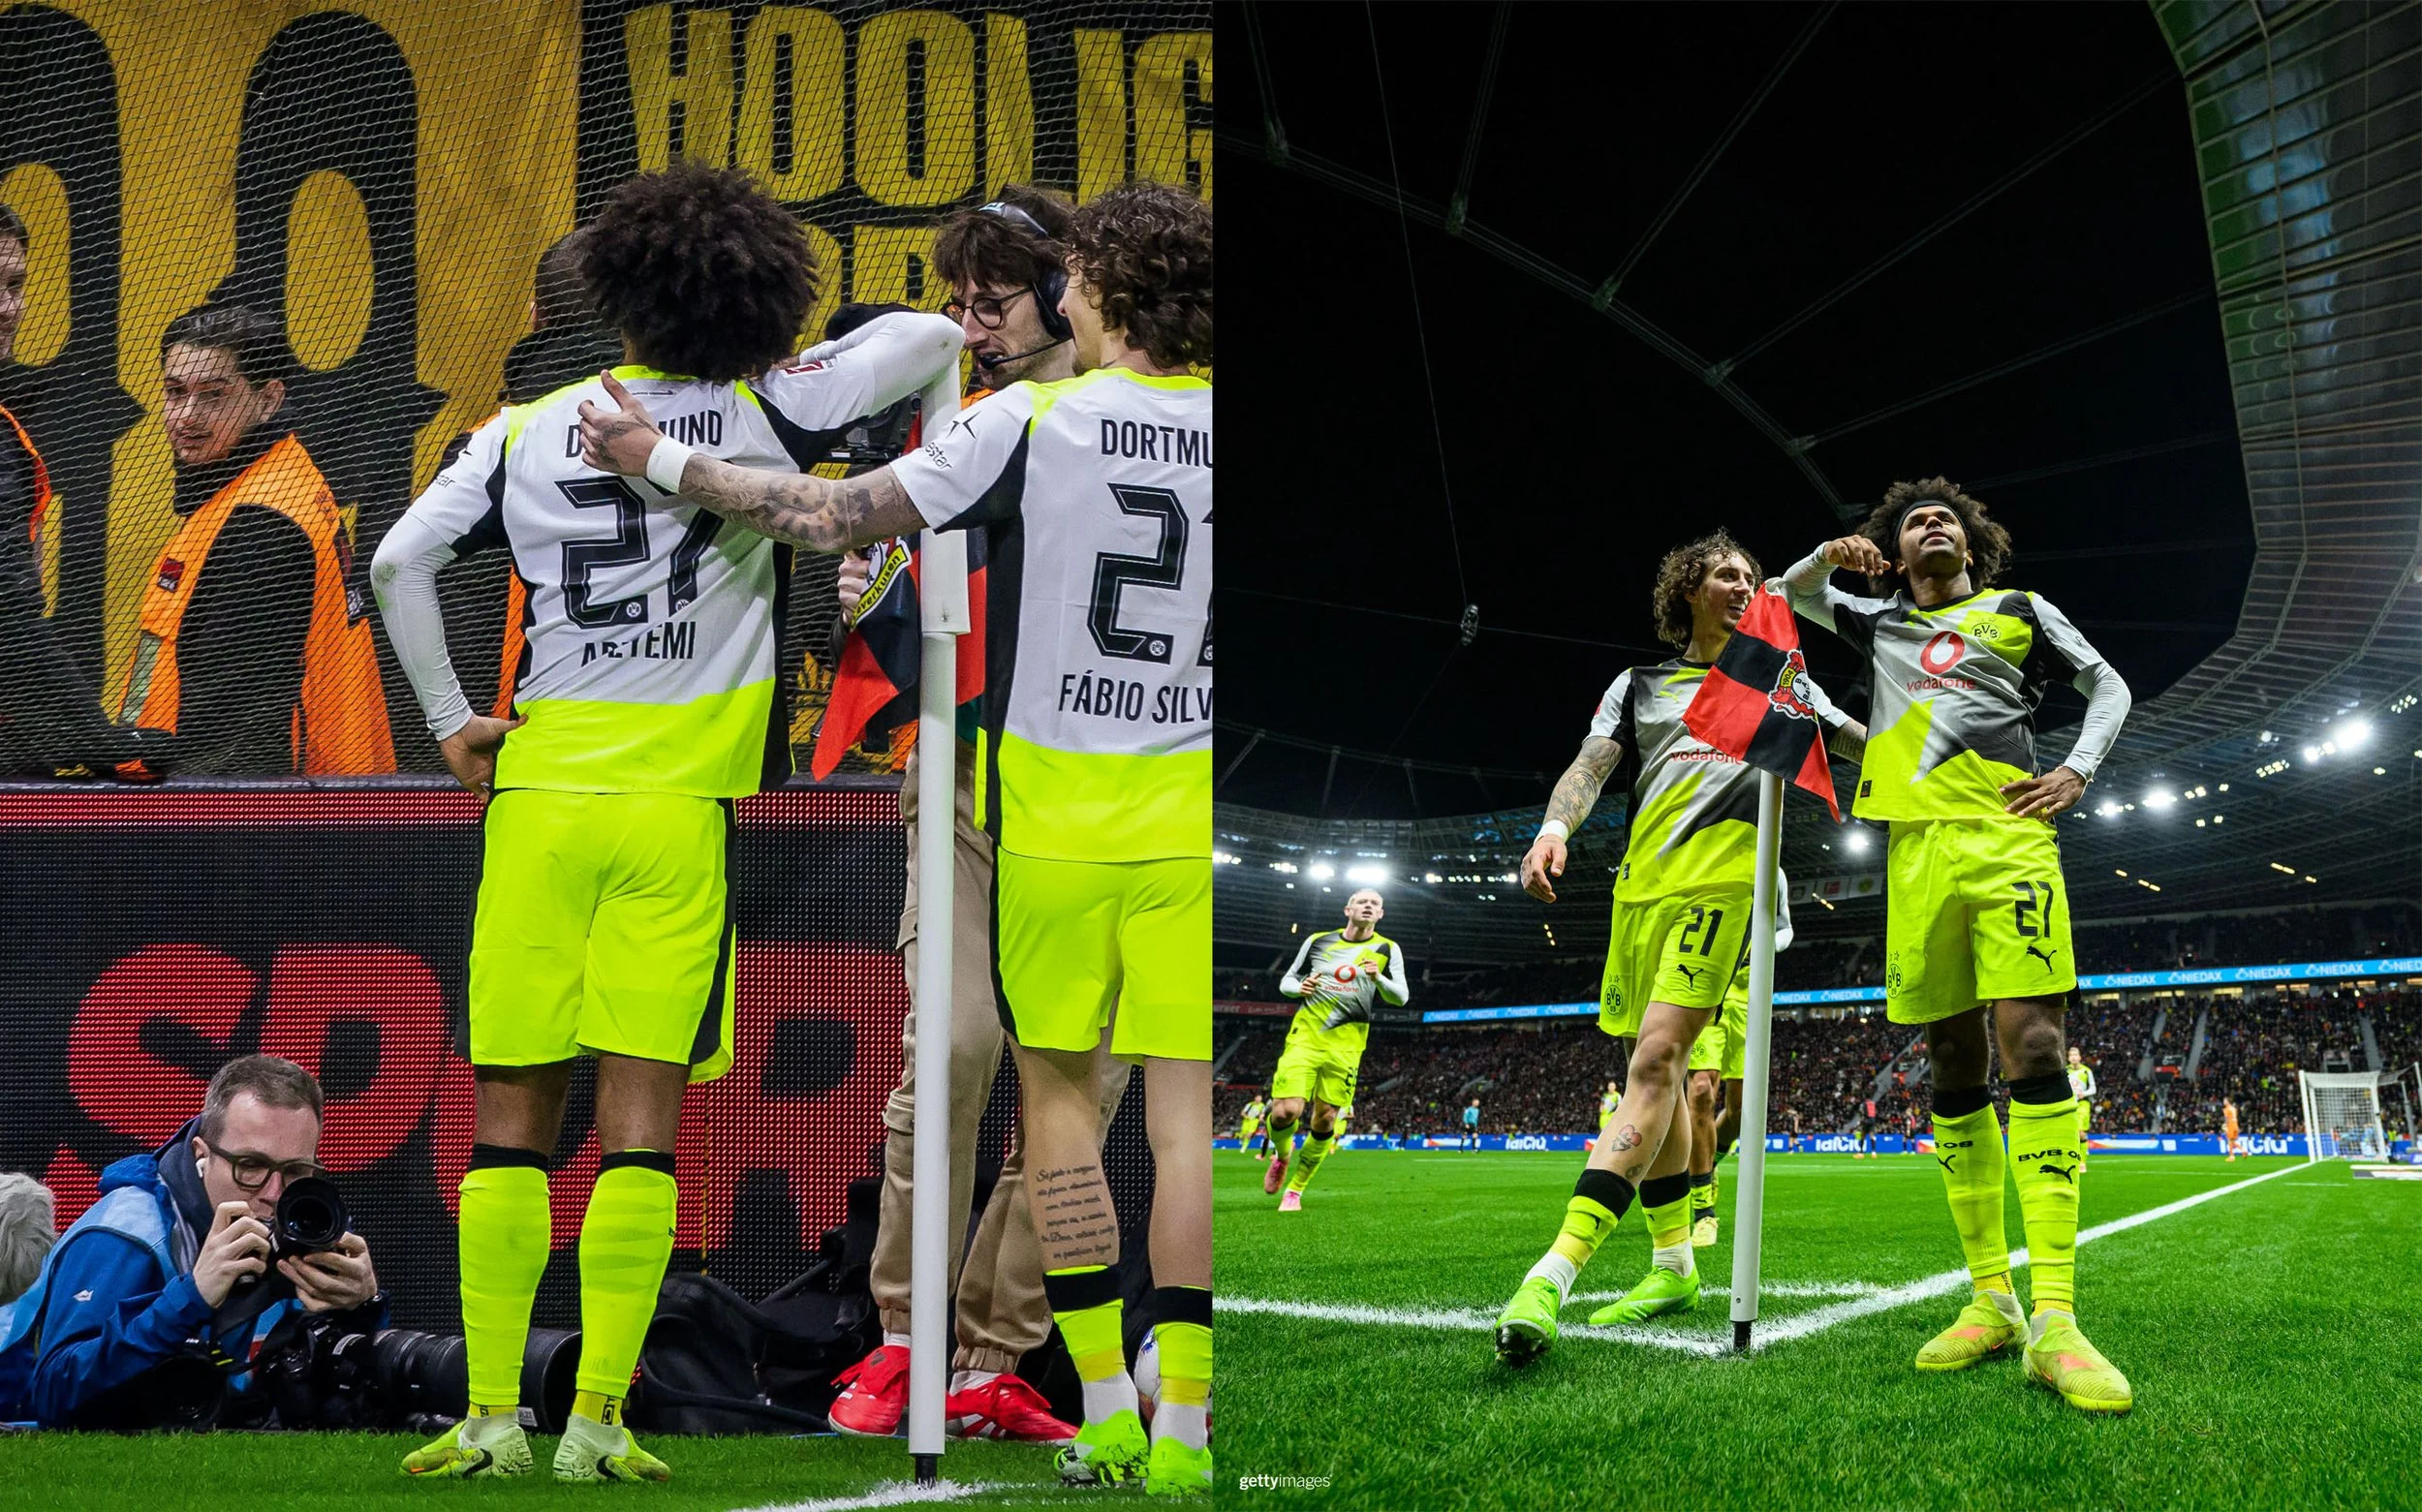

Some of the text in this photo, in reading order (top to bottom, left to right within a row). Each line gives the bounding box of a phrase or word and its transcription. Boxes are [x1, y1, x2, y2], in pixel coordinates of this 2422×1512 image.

[1101, 418, 1212, 468] DORTMU
[1087, 482, 1212, 666] 2
[854, 555, 902, 616] everkusen
[1783, 669, 1793, 686] 1904
[1907, 676, 1977, 692] vodafone
[1058, 669, 1212, 724] FÁBIO SILV
[2011, 880, 2054, 938] 27
[1679, 907, 1723, 957] 21
[2182, 972, 2221, 983] NIEDAX
[2248, 968, 2291, 979] NIEDAX
[2319, 964, 2364, 975] NIEDAX
[2117, 974, 2156, 986] NIEDAX
[1606, 988, 1621, 1007] BVB
[1830, 991, 1863, 1001] NIEDAX
[2018, 1149, 2063, 1162] BVB
